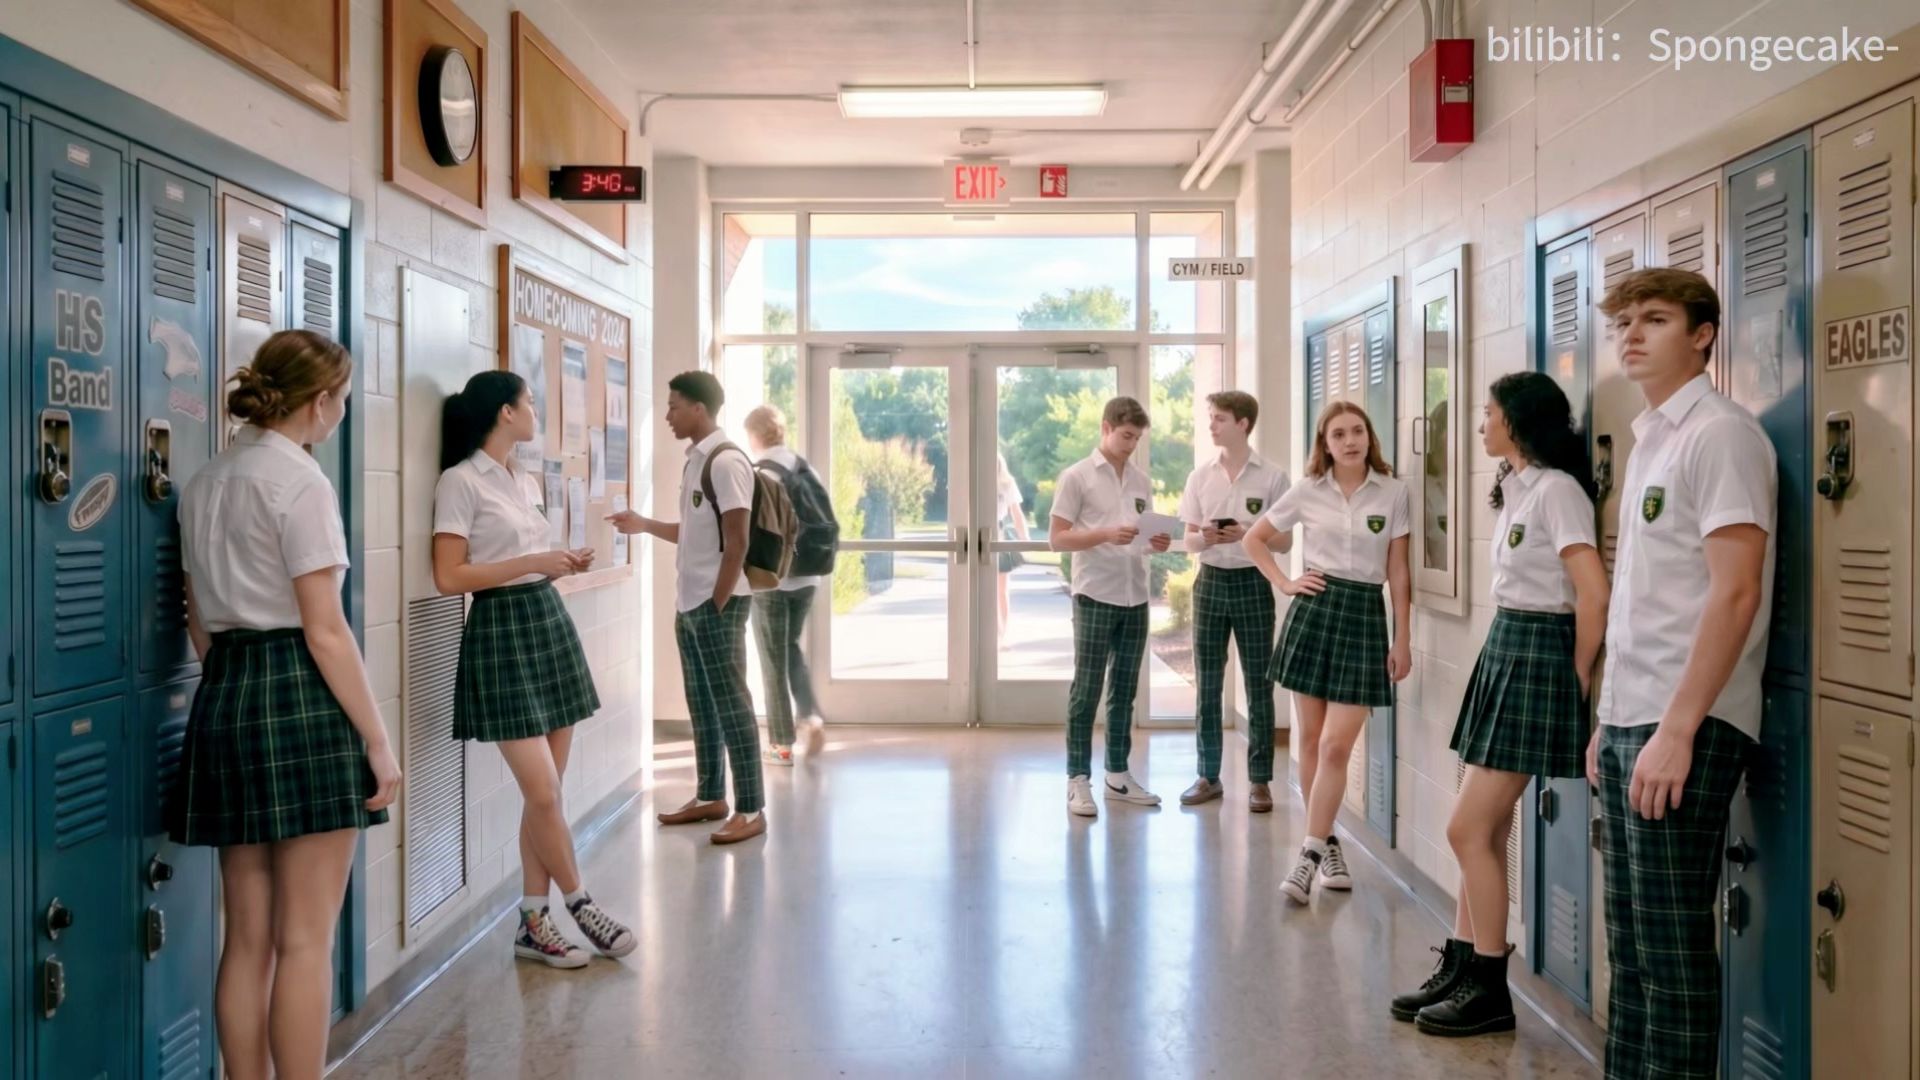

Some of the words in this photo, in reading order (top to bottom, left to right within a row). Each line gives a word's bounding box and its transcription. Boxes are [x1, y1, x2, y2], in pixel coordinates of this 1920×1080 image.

[955, 165, 998, 200] EXIT
[1211, 263, 1245, 276] FIELD
[56, 289, 105, 355] HS
[515, 273, 597, 342] HOMECOMING
[601, 311, 626, 350] 2024
[1828, 312, 1905, 366] EAGLES
[49, 357, 112, 411] Band
